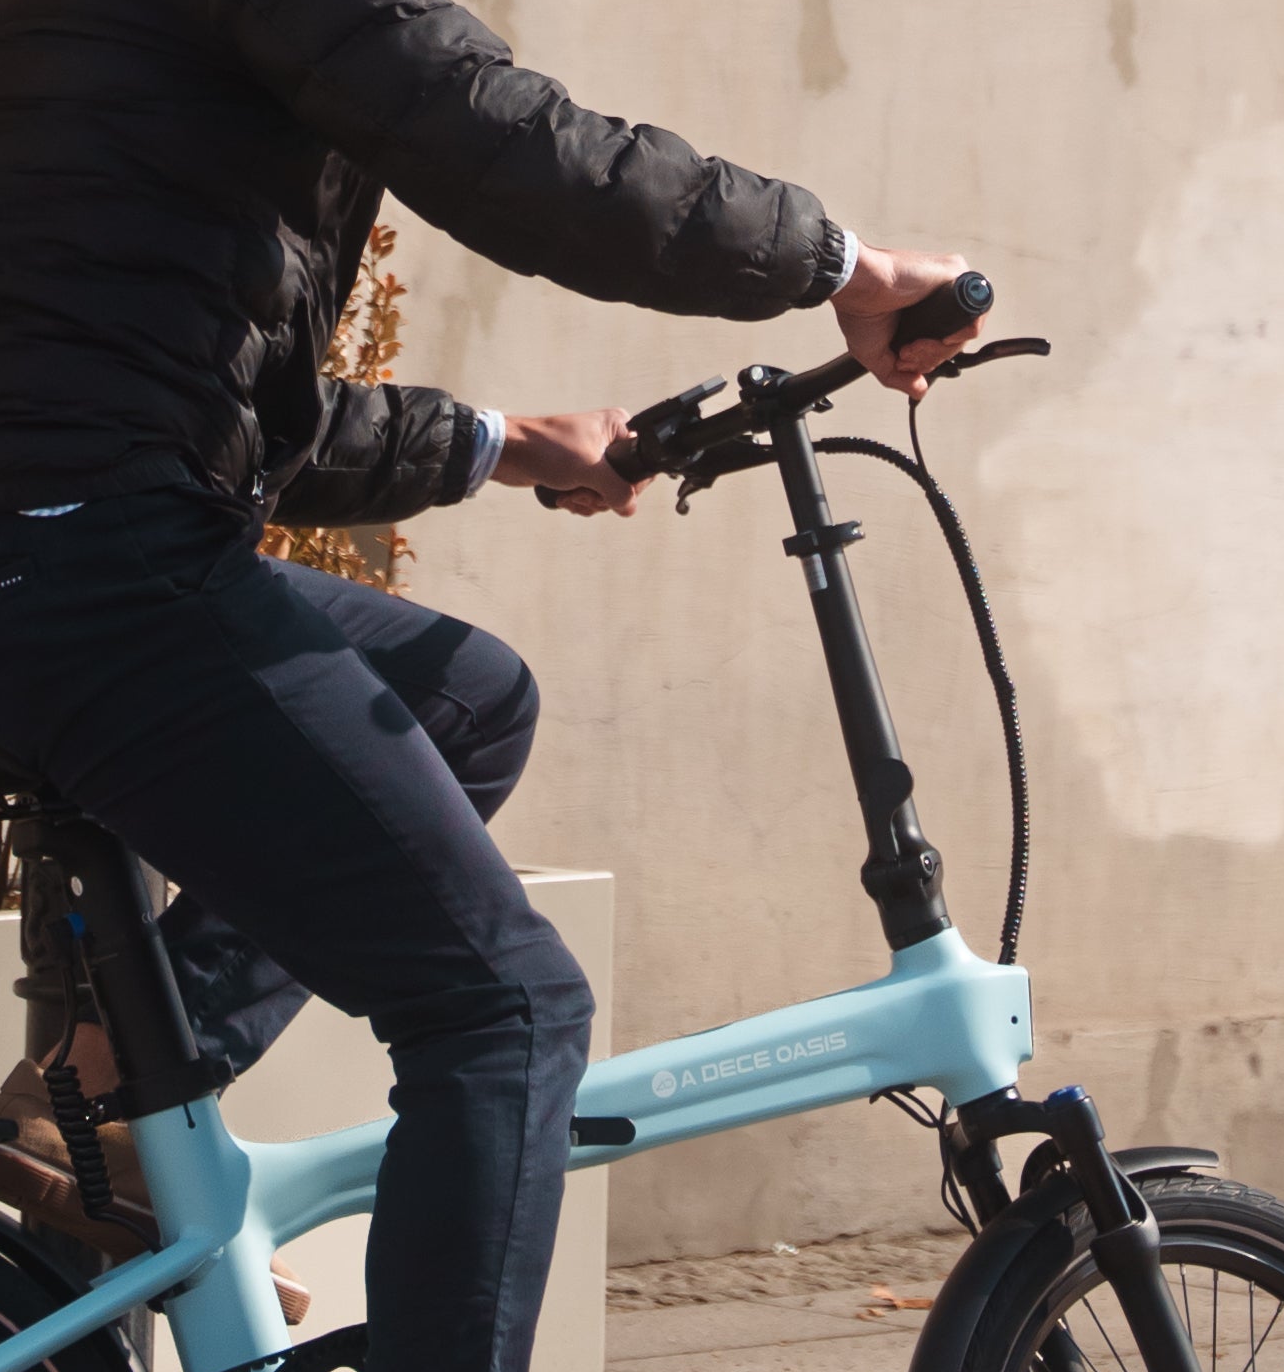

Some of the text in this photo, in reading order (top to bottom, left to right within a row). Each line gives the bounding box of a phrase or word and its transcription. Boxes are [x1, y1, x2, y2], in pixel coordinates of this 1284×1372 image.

[681, 1070, 697, 1088] A
[701, 1050, 772, 1083] DECE
[776, 1032, 847, 1063] OASIS
